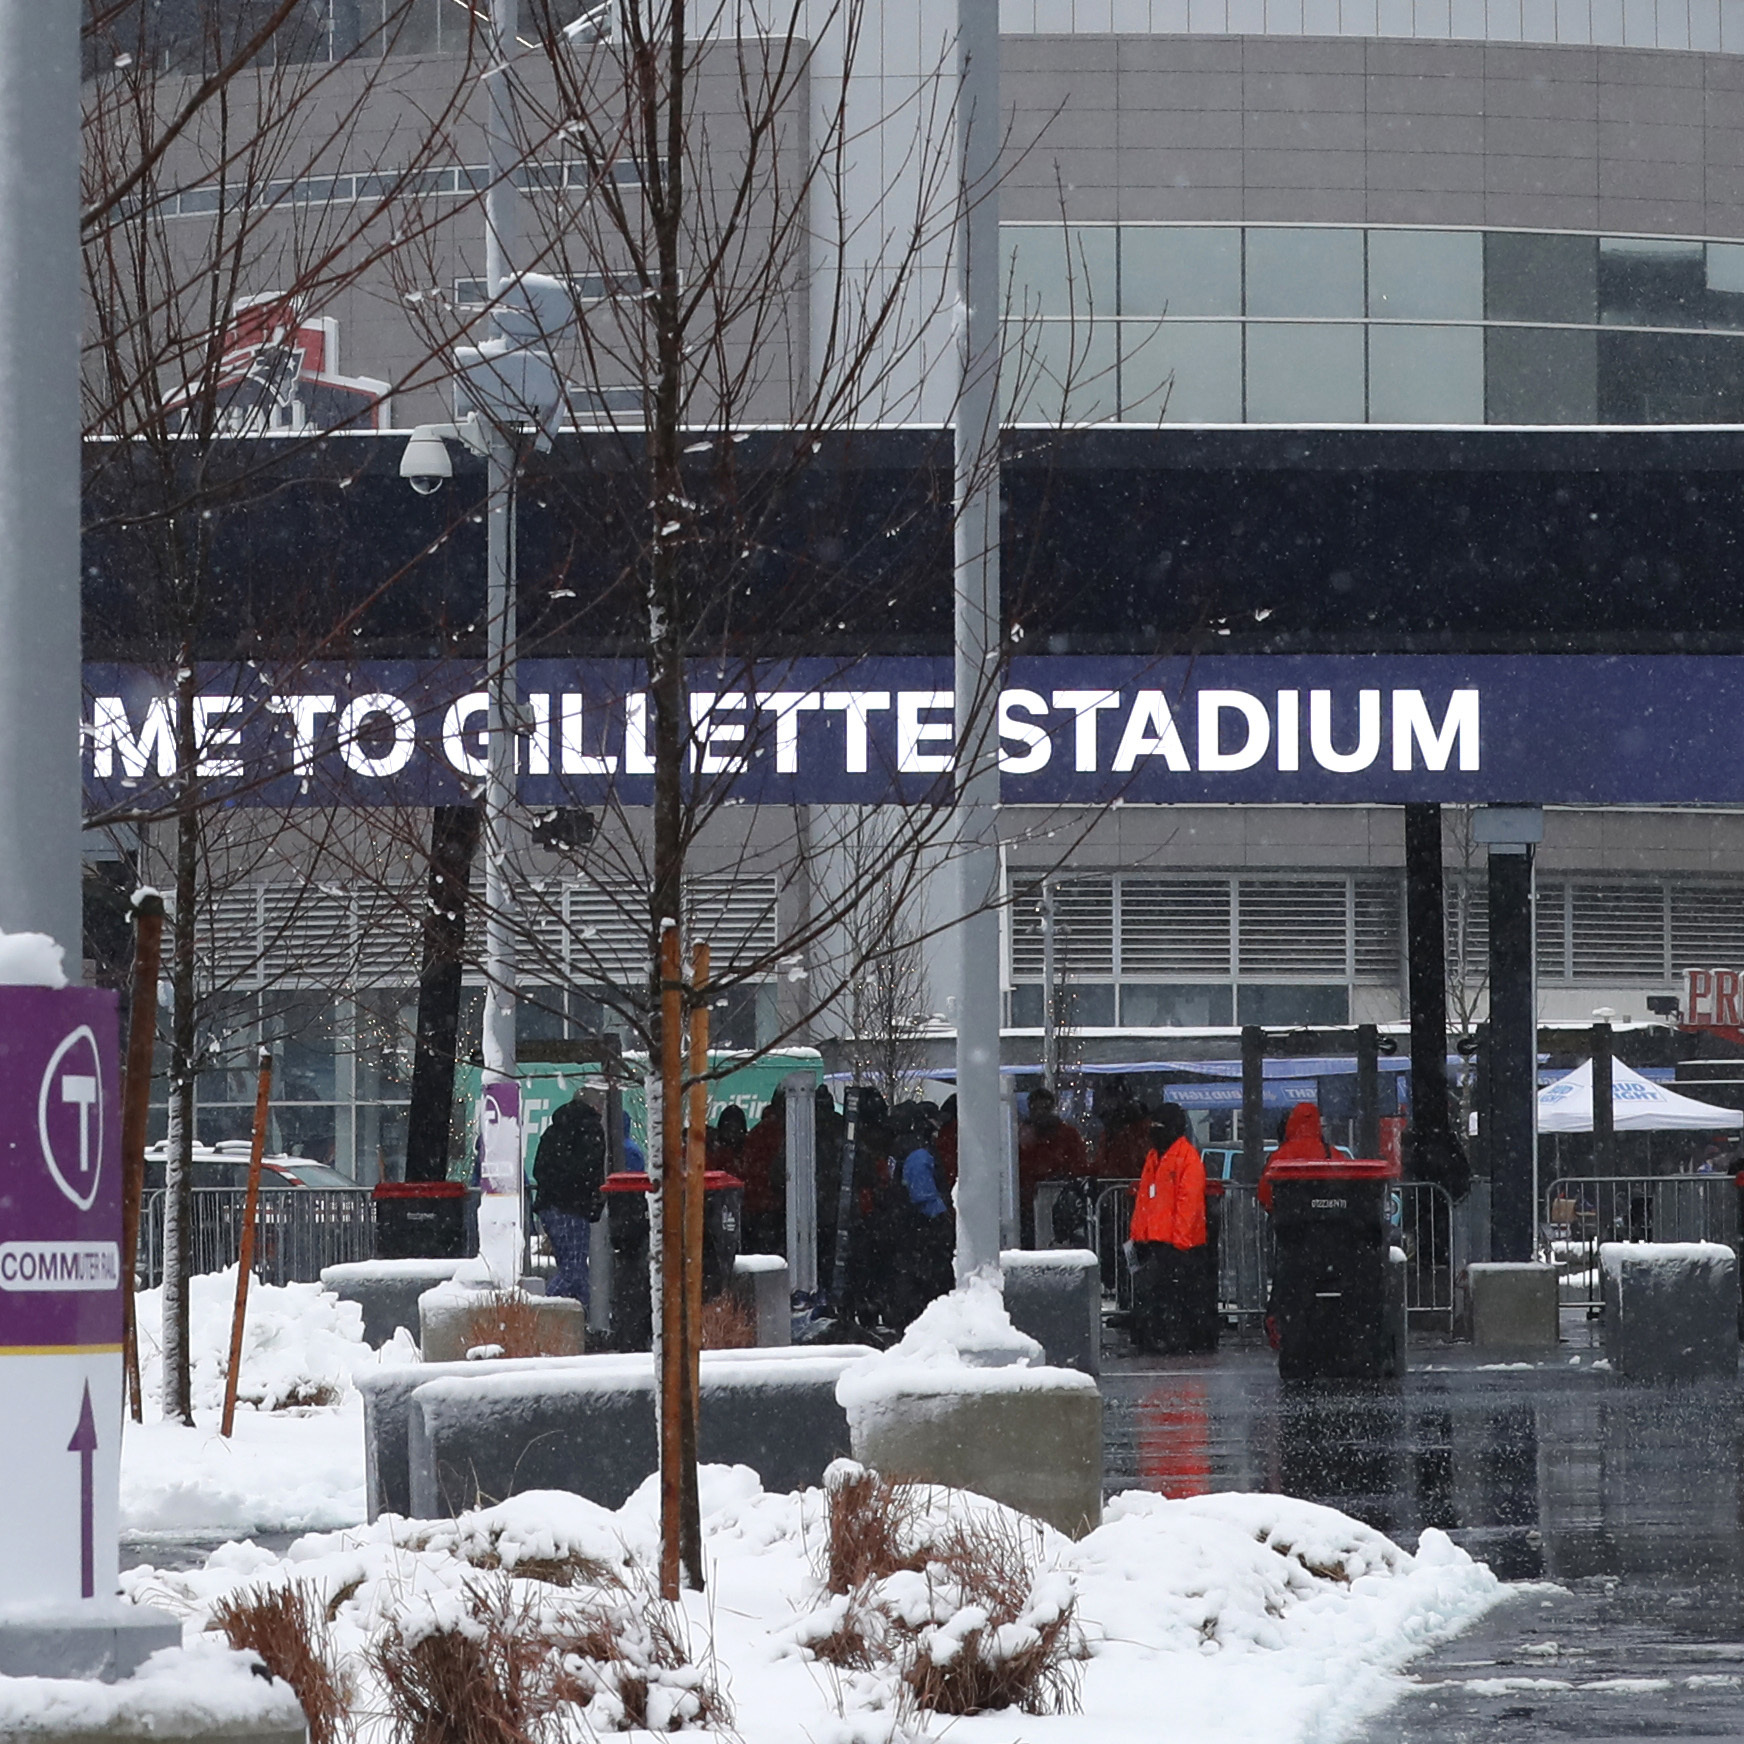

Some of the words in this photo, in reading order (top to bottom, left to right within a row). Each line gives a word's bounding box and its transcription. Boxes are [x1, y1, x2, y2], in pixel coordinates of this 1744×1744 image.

[272, 692, 415, 778] TO
[442, 691, 953, 776] GILLETTE
[997, 689, 1479, 774] STADIUM
[1612, 1091, 1659, 1101] IGHT
